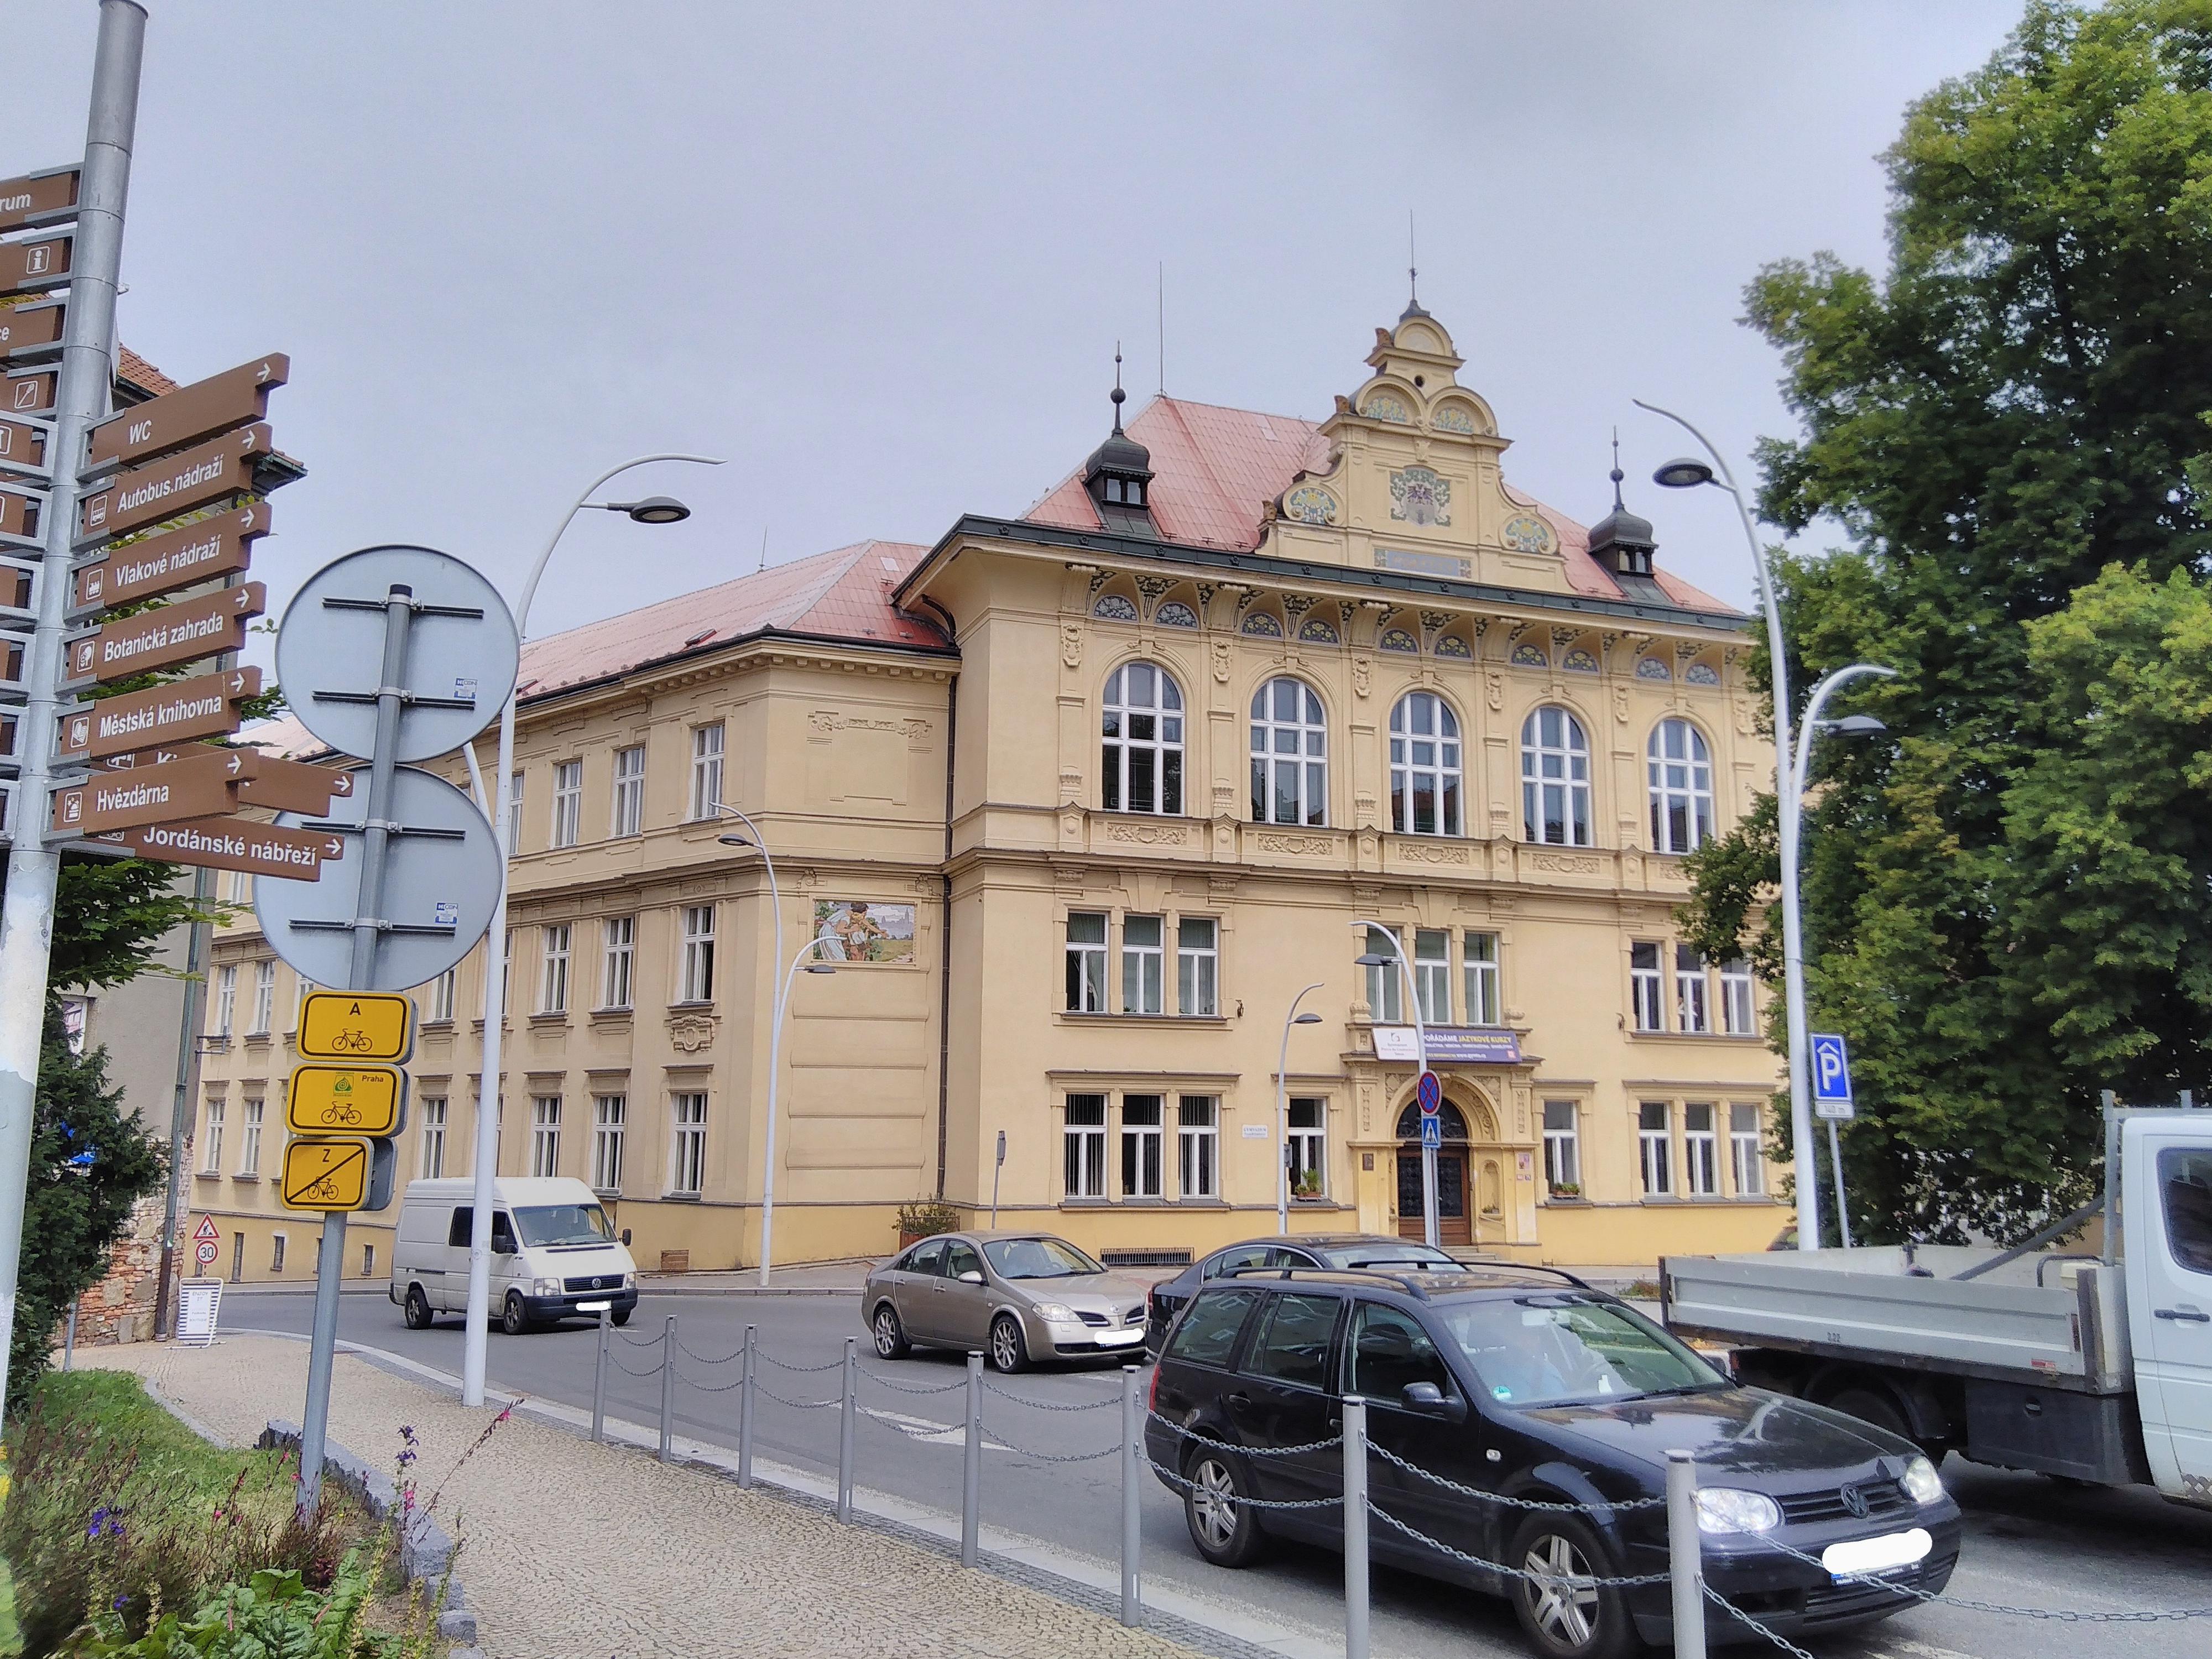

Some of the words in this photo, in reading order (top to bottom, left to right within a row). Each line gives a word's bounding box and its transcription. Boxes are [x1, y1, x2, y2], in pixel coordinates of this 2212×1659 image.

[129, 420, 152, 445] WC
[117, 453, 224, 513] Autobus.nádraží
[116, 552, 167, 587] Vlakové
[170, 534, 221, 570] nádraží
[104, 624, 167, 662] Botanická
[170, 611, 223, 645] zahrada
[100, 705, 154, 738] Městská
[158, 695, 222, 726] knihovna
[97, 782, 169, 812] Hvězdárna
[143, 826, 245, 856] Jordánské
[251, 841, 317, 867] nábřeží
[349, 1002, 361, 1016] A
[1820, 1052, 1840, 1090] P
[322, 1149, 330, 1162] Z
[200, 1246, 214, 1258] 30
